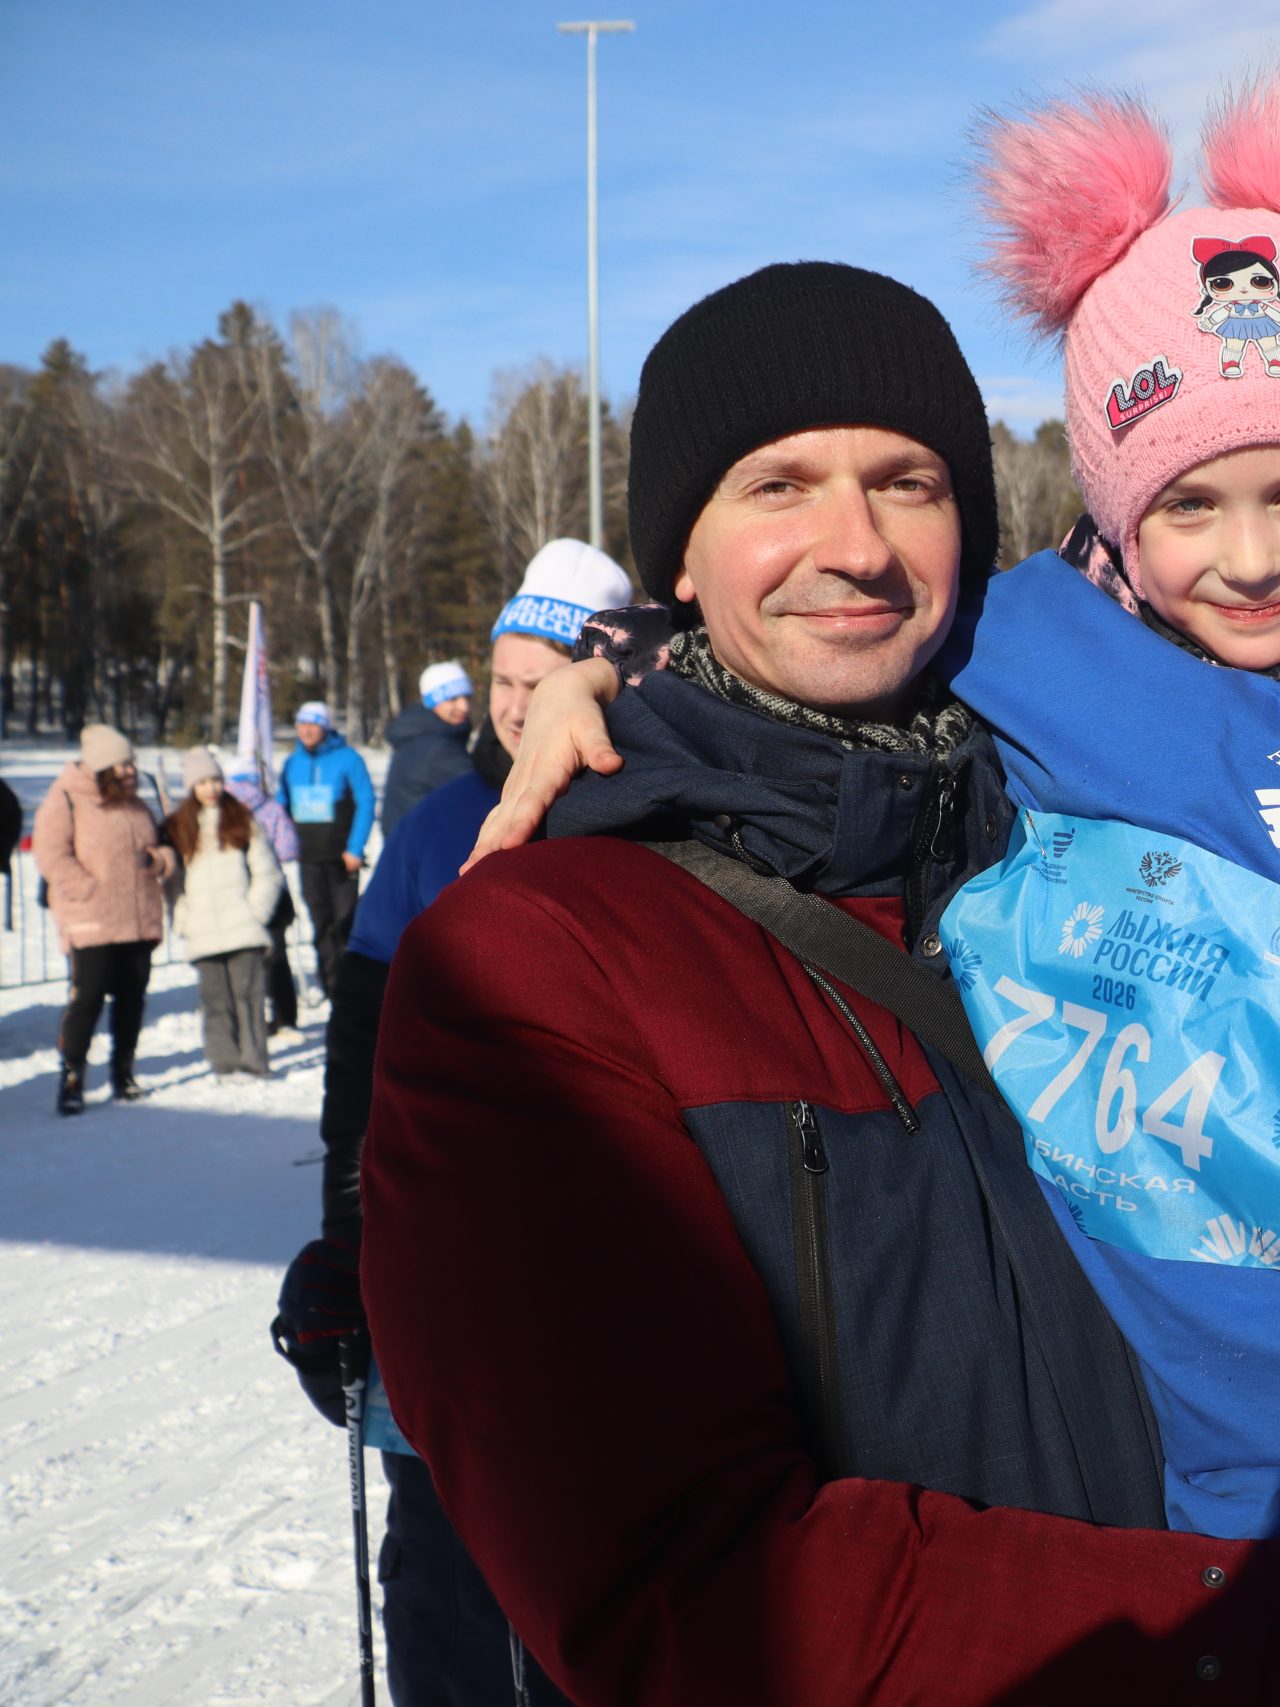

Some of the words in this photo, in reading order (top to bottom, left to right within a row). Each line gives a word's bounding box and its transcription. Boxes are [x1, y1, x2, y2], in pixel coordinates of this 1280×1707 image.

[1120, 390, 1168, 422] SURPRISE!
[1093, 938, 1217, 1002] РОССИИ
[1106, 909, 1231, 974] ЛЫЖНЯ
[1092, 974, 1137, 1011] 2026
[983, 975, 1227, 1172] 7764
[1027, 1133, 1196, 1194] БИНСКАЯ
